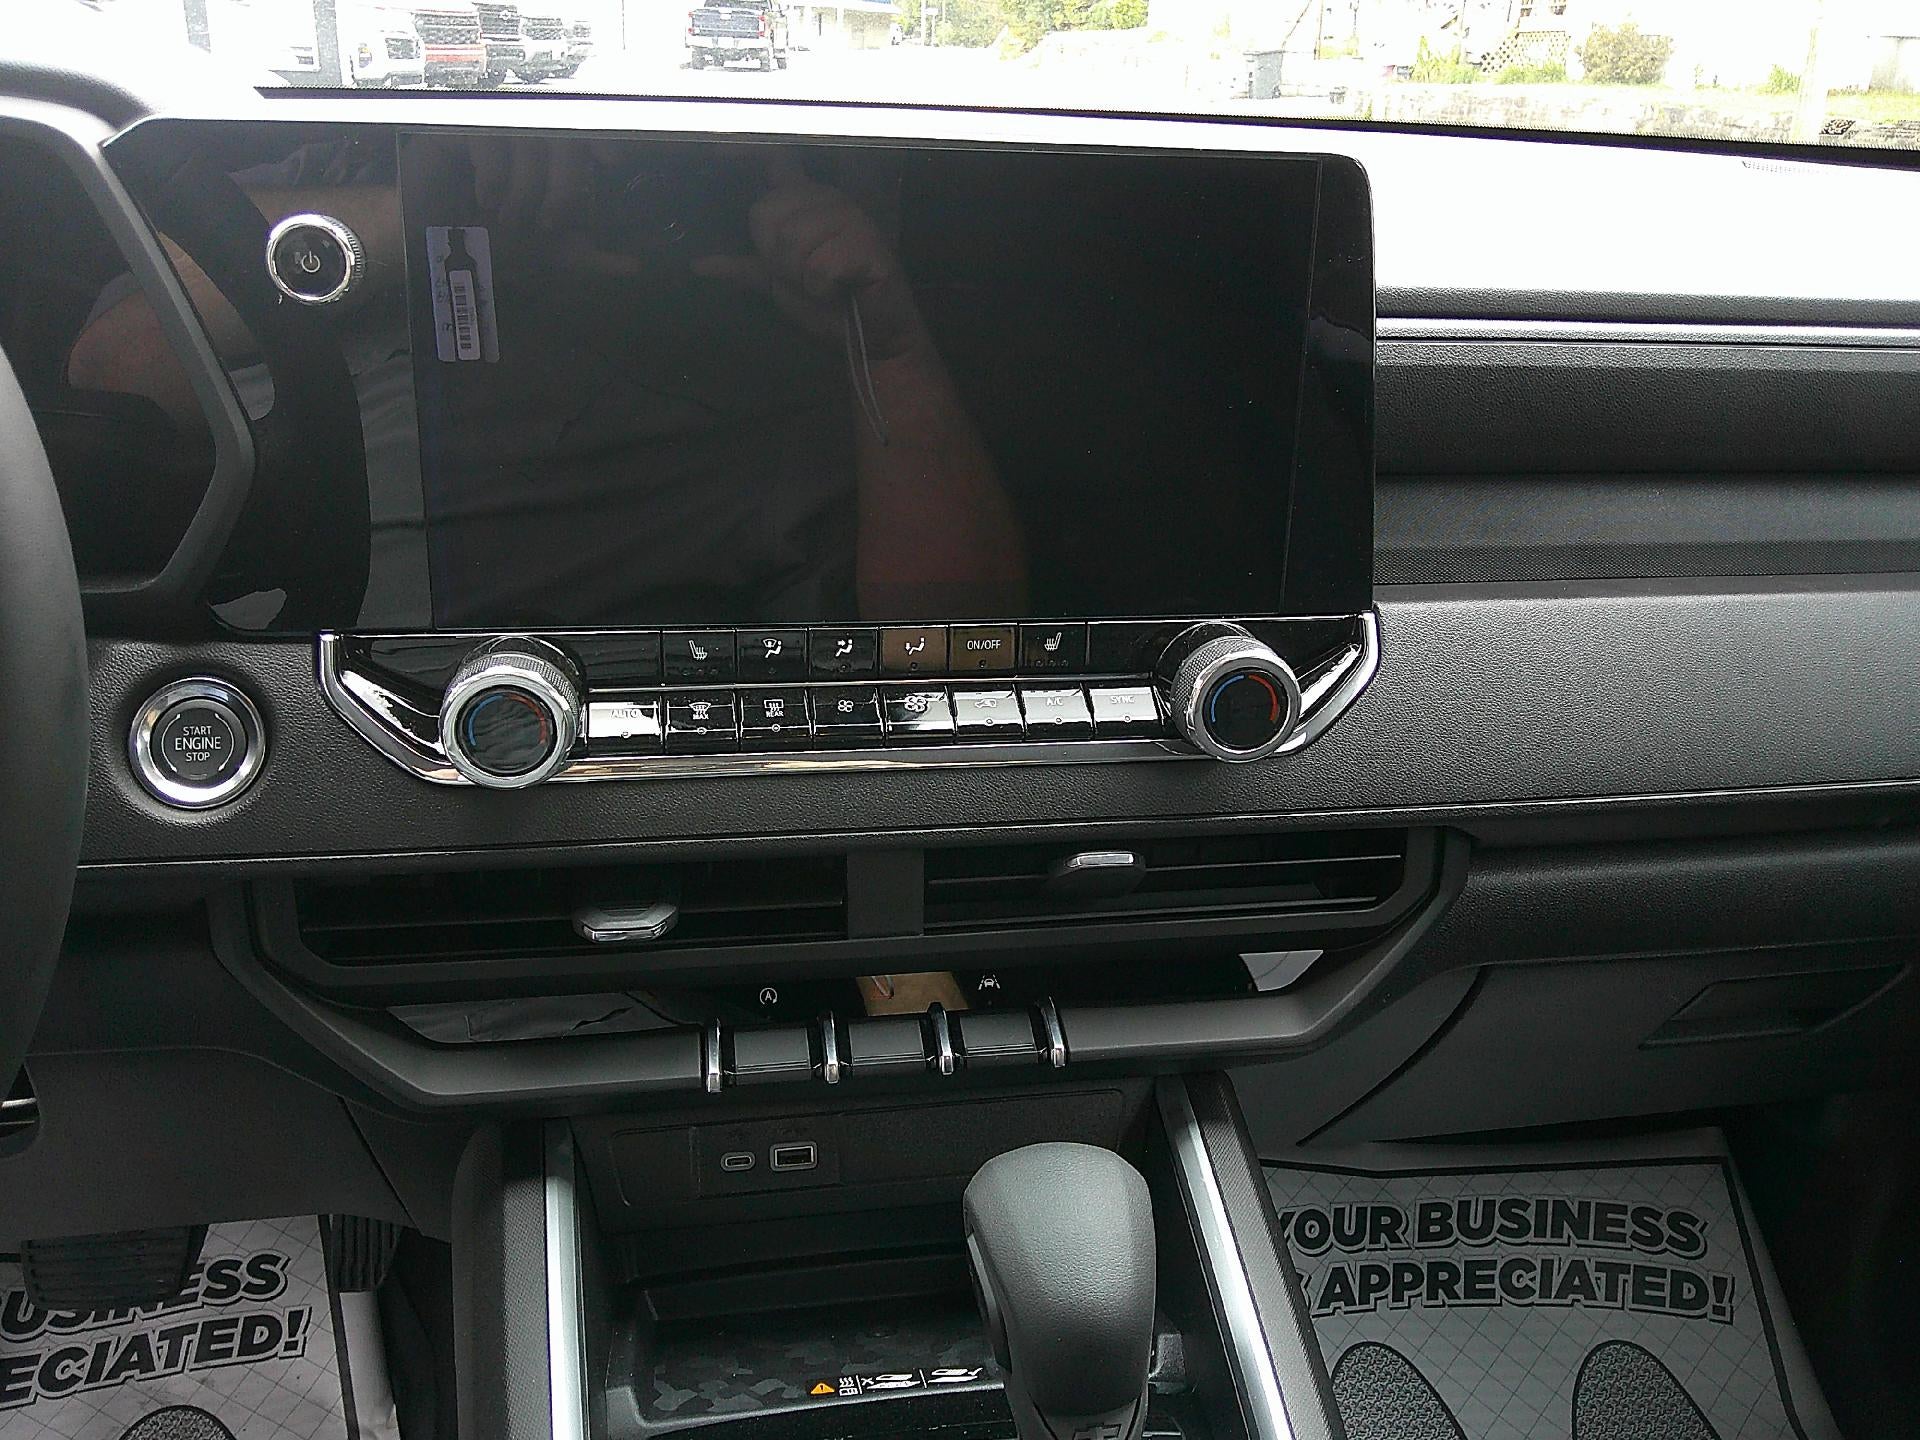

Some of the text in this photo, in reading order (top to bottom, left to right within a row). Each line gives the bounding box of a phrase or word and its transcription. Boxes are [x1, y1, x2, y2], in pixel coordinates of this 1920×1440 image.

[966, 639, 1001, 651] ON/OFF
[1046, 696, 1063, 706] A/C
[1110, 695, 1136, 705] SYNC
[611, 708, 642, 719] AUTO
[765, 710, 785, 718] REAR
[183, 725, 213, 736] START
[175, 736, 222, 751] ENGINE
[185, 752, 211, 762] STOP
[1413, 1198, 1707, 1257] BUSINESS
[1312, 1255, 1734, 1324] APPRECIATED!
